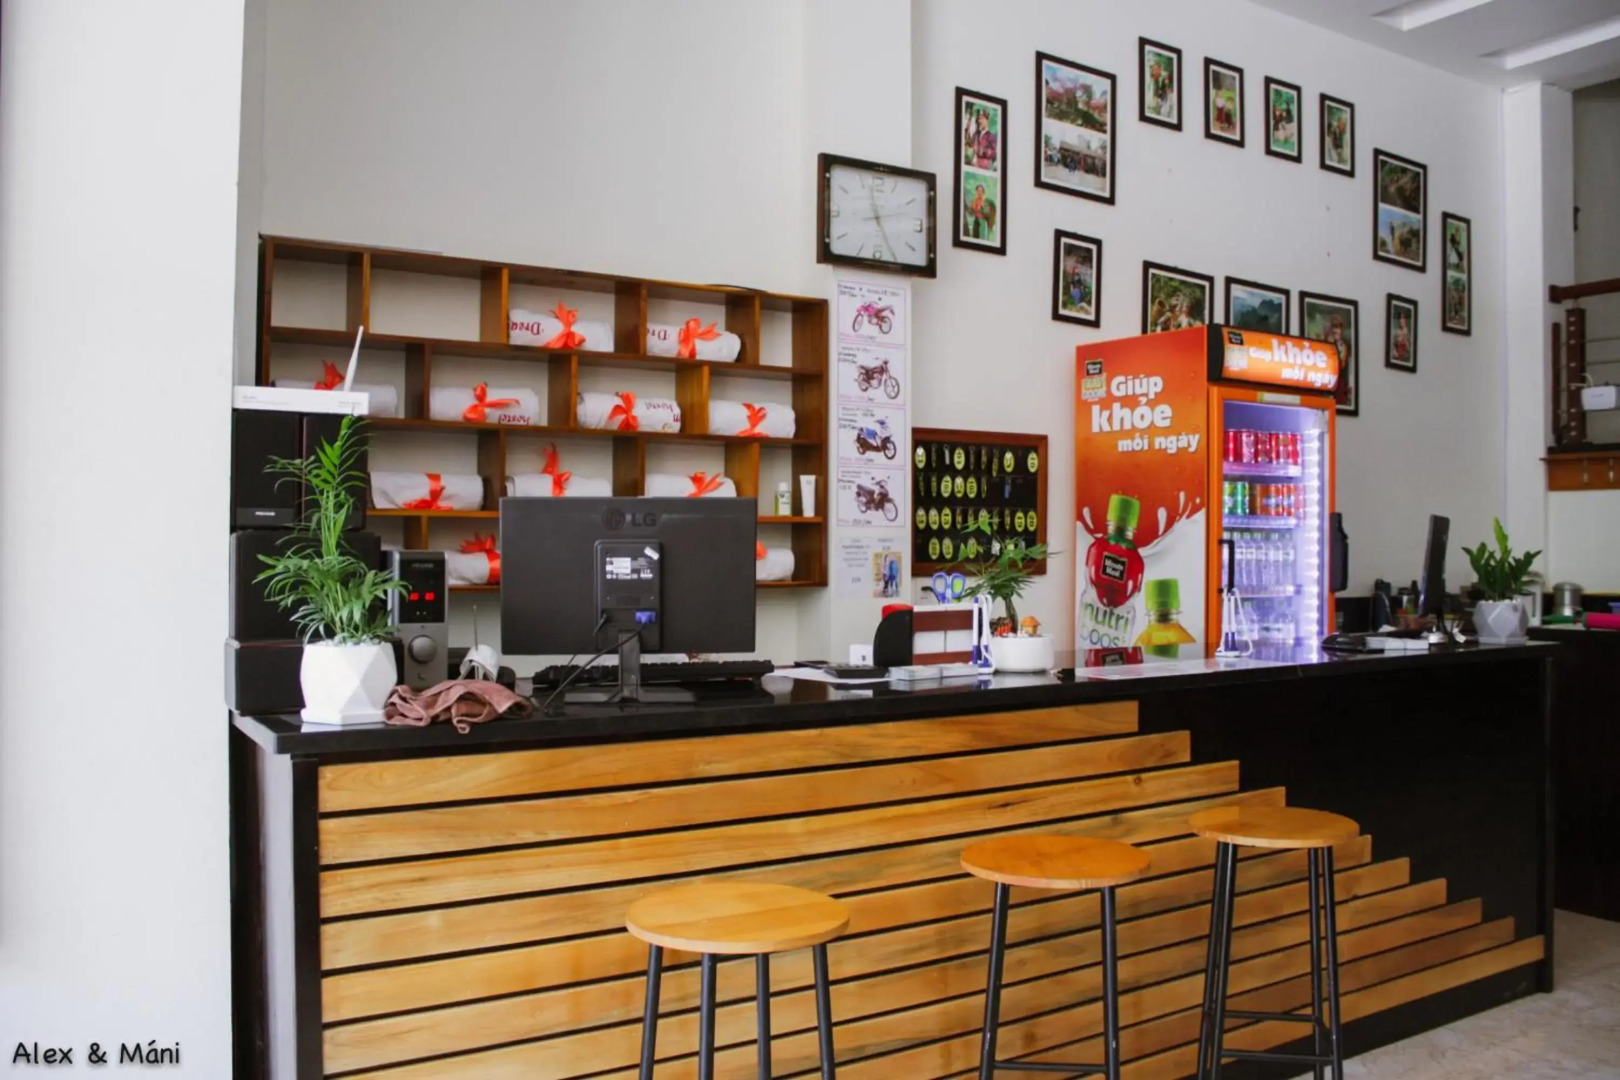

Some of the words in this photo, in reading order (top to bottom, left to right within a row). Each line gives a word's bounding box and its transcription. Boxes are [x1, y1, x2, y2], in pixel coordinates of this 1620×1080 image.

[1110, 374, 1163, 399] Giúp
[1091, 396, 1173, 433] khỏe
[631, 512, 657, 527] LG
[1084, 601, 1131, 633] nutri
